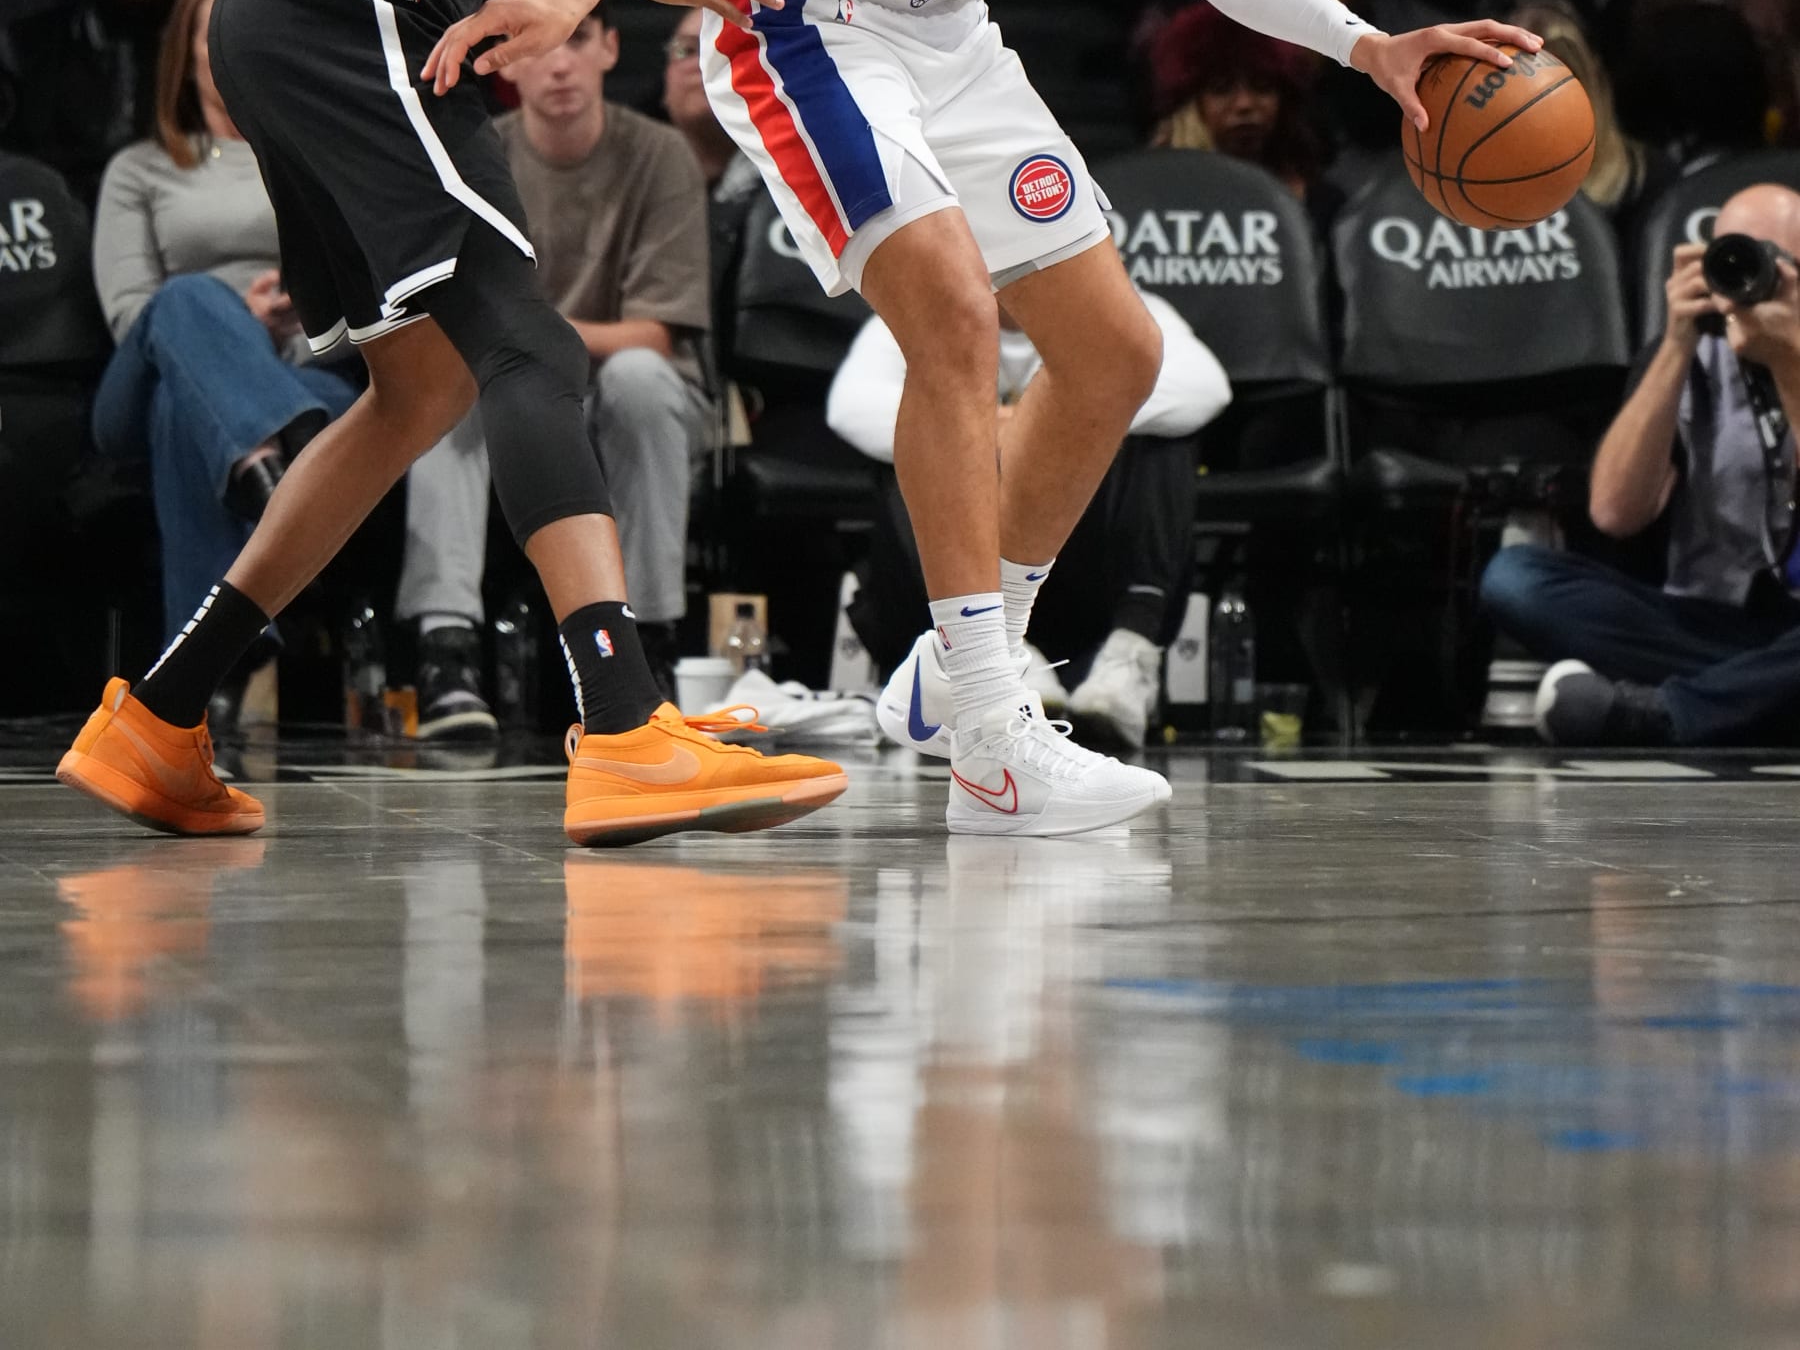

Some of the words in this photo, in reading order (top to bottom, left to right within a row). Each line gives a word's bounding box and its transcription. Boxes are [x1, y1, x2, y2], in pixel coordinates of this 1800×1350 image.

[1021, 172, 1060, 194] DETROIT
[1024, 182, 1065, 205] PISTONS
[1131, 255, 1283, 285] AIRWAYS
[1428, 250, 1582, 290] AIRWAYS
